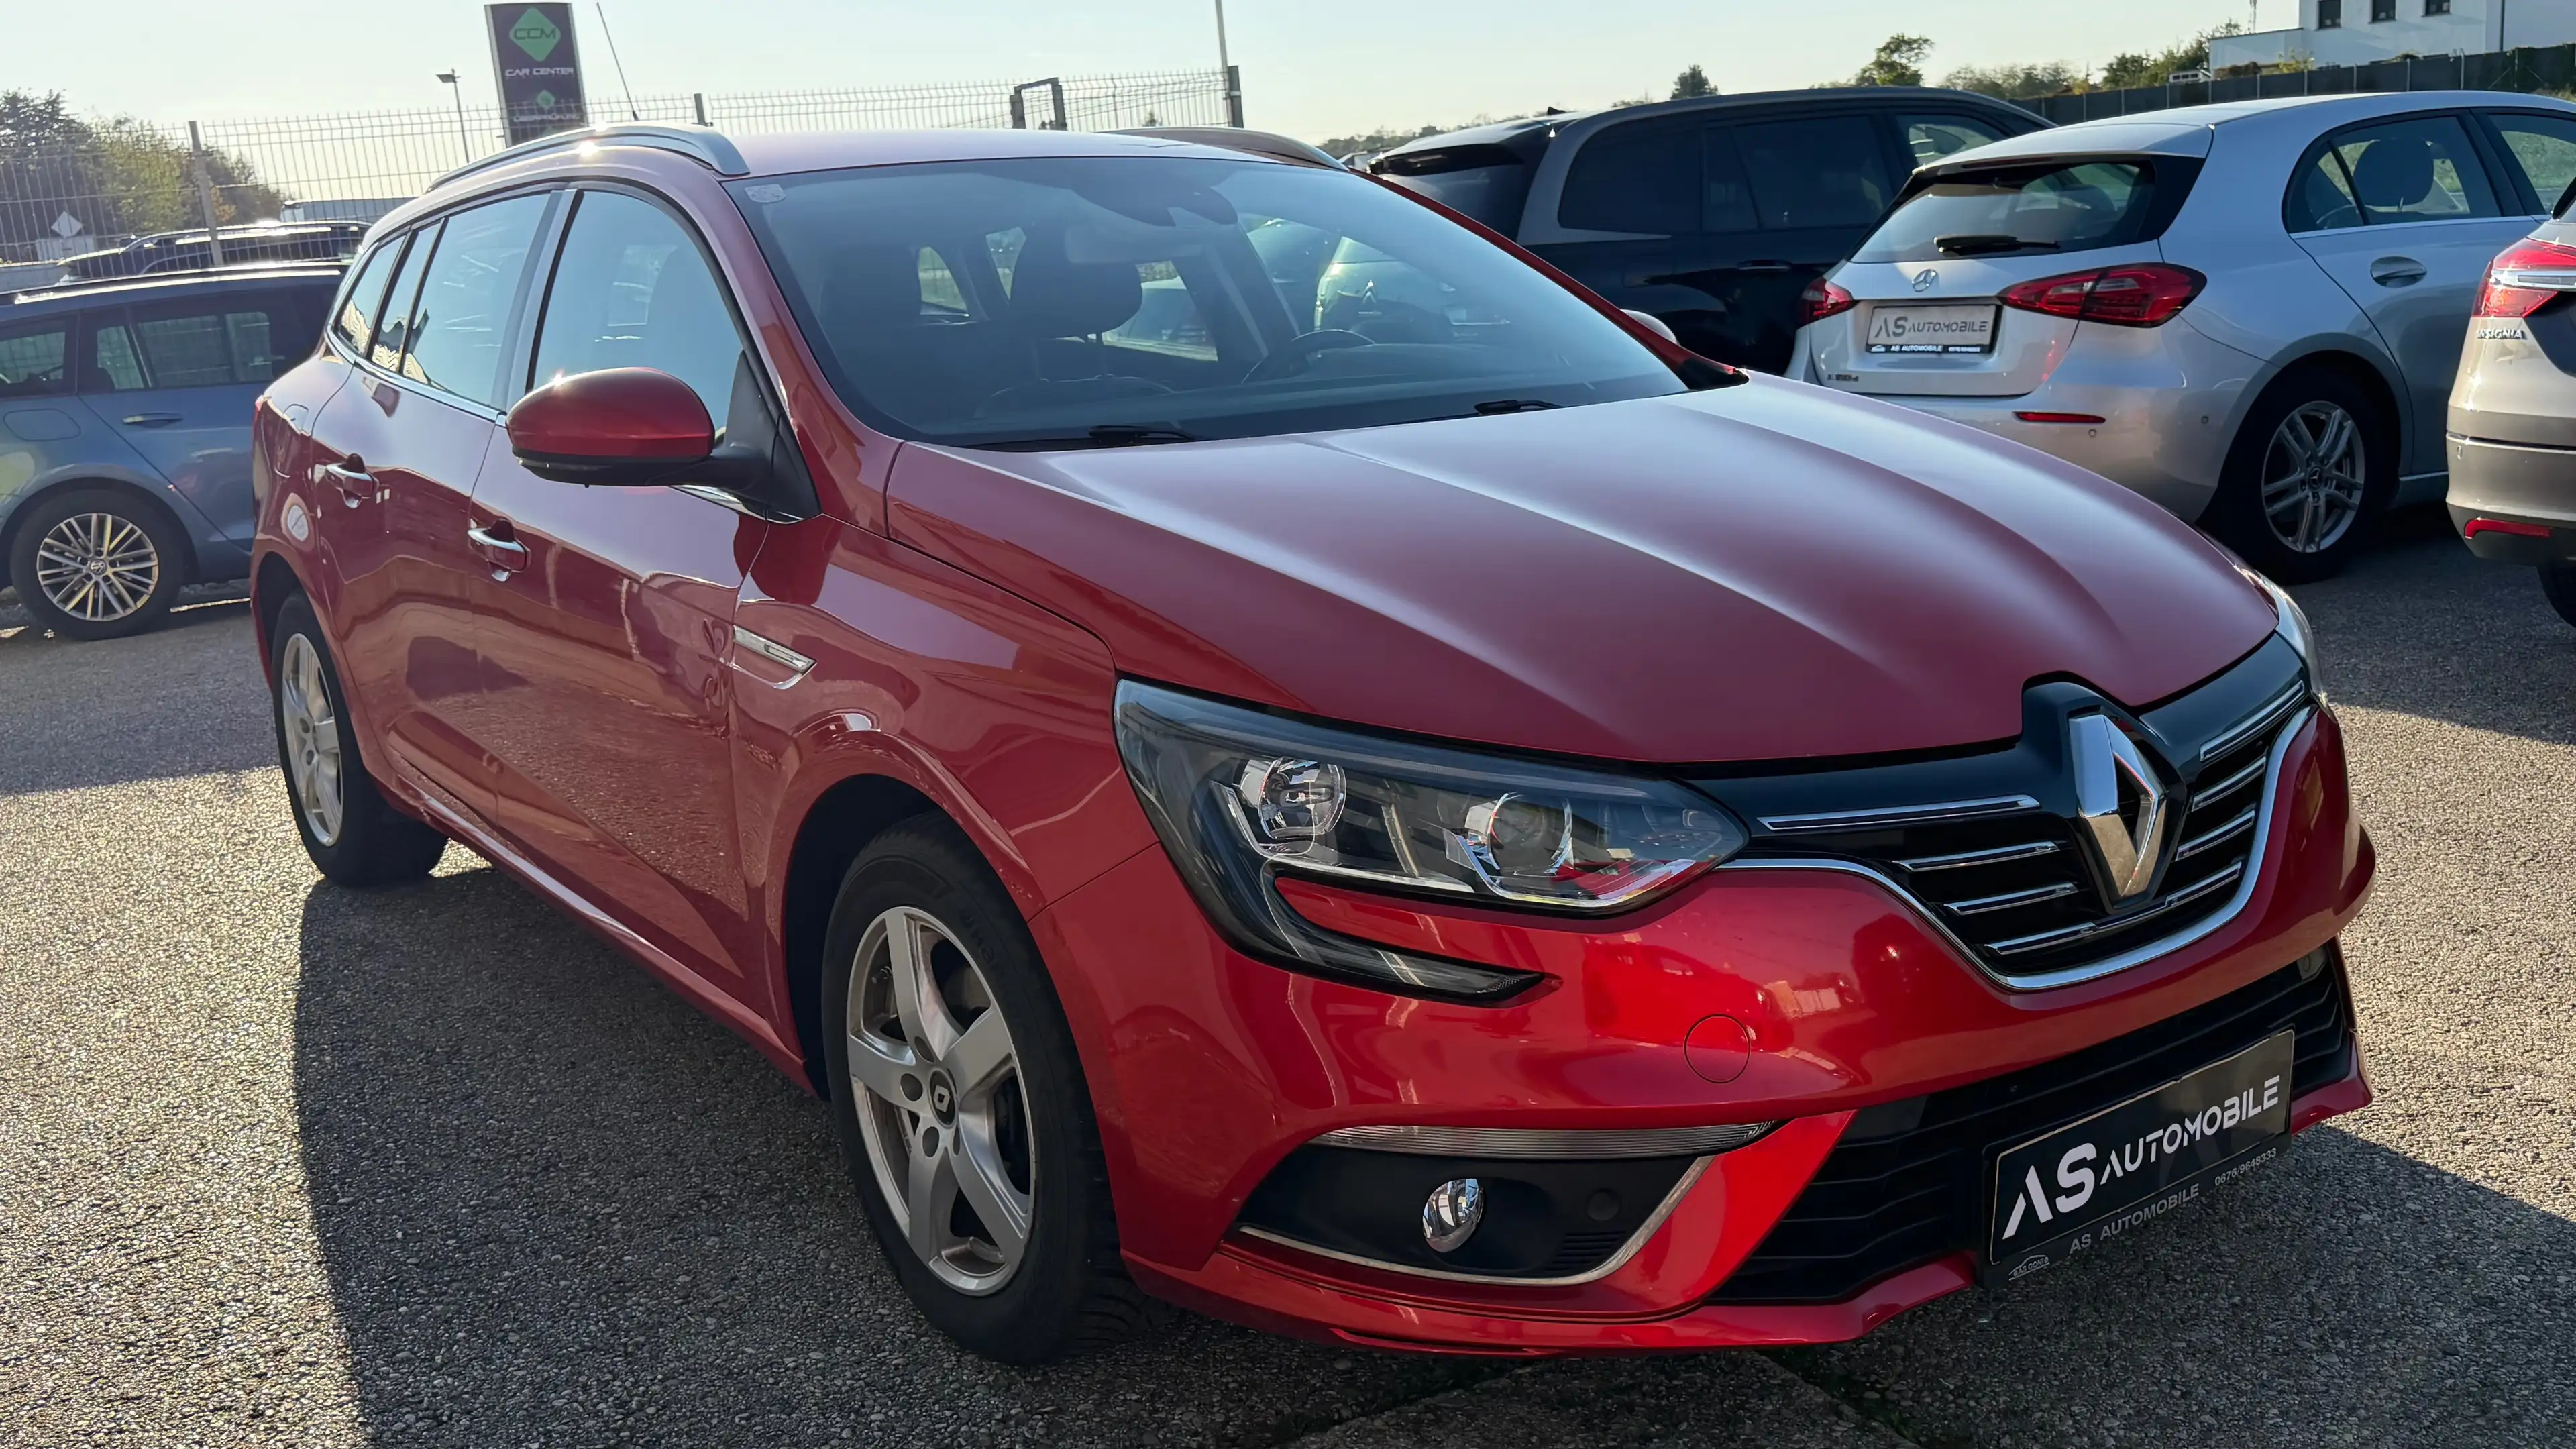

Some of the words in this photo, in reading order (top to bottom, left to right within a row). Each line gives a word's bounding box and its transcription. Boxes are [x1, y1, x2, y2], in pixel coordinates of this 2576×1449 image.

[513, 28, 557, 40] CCM
[505, 68, 530, 77] CAR
[533, 67, 574, 75] CENTER
[1874, 316, 1908, 337] AS
[1908, 321, 1989, 333] AUTOMOBILE
[2476, 328, 2525, 339] INSIGNIA
[2002, 1142, 2098, 1240] AS
[2100, 1075, 2280, 1185] AUTOMOBILE
[2069, 1233, 2092, 1254] AS
[2100, 1183, 2200, 1240] AUTOMOBILE
